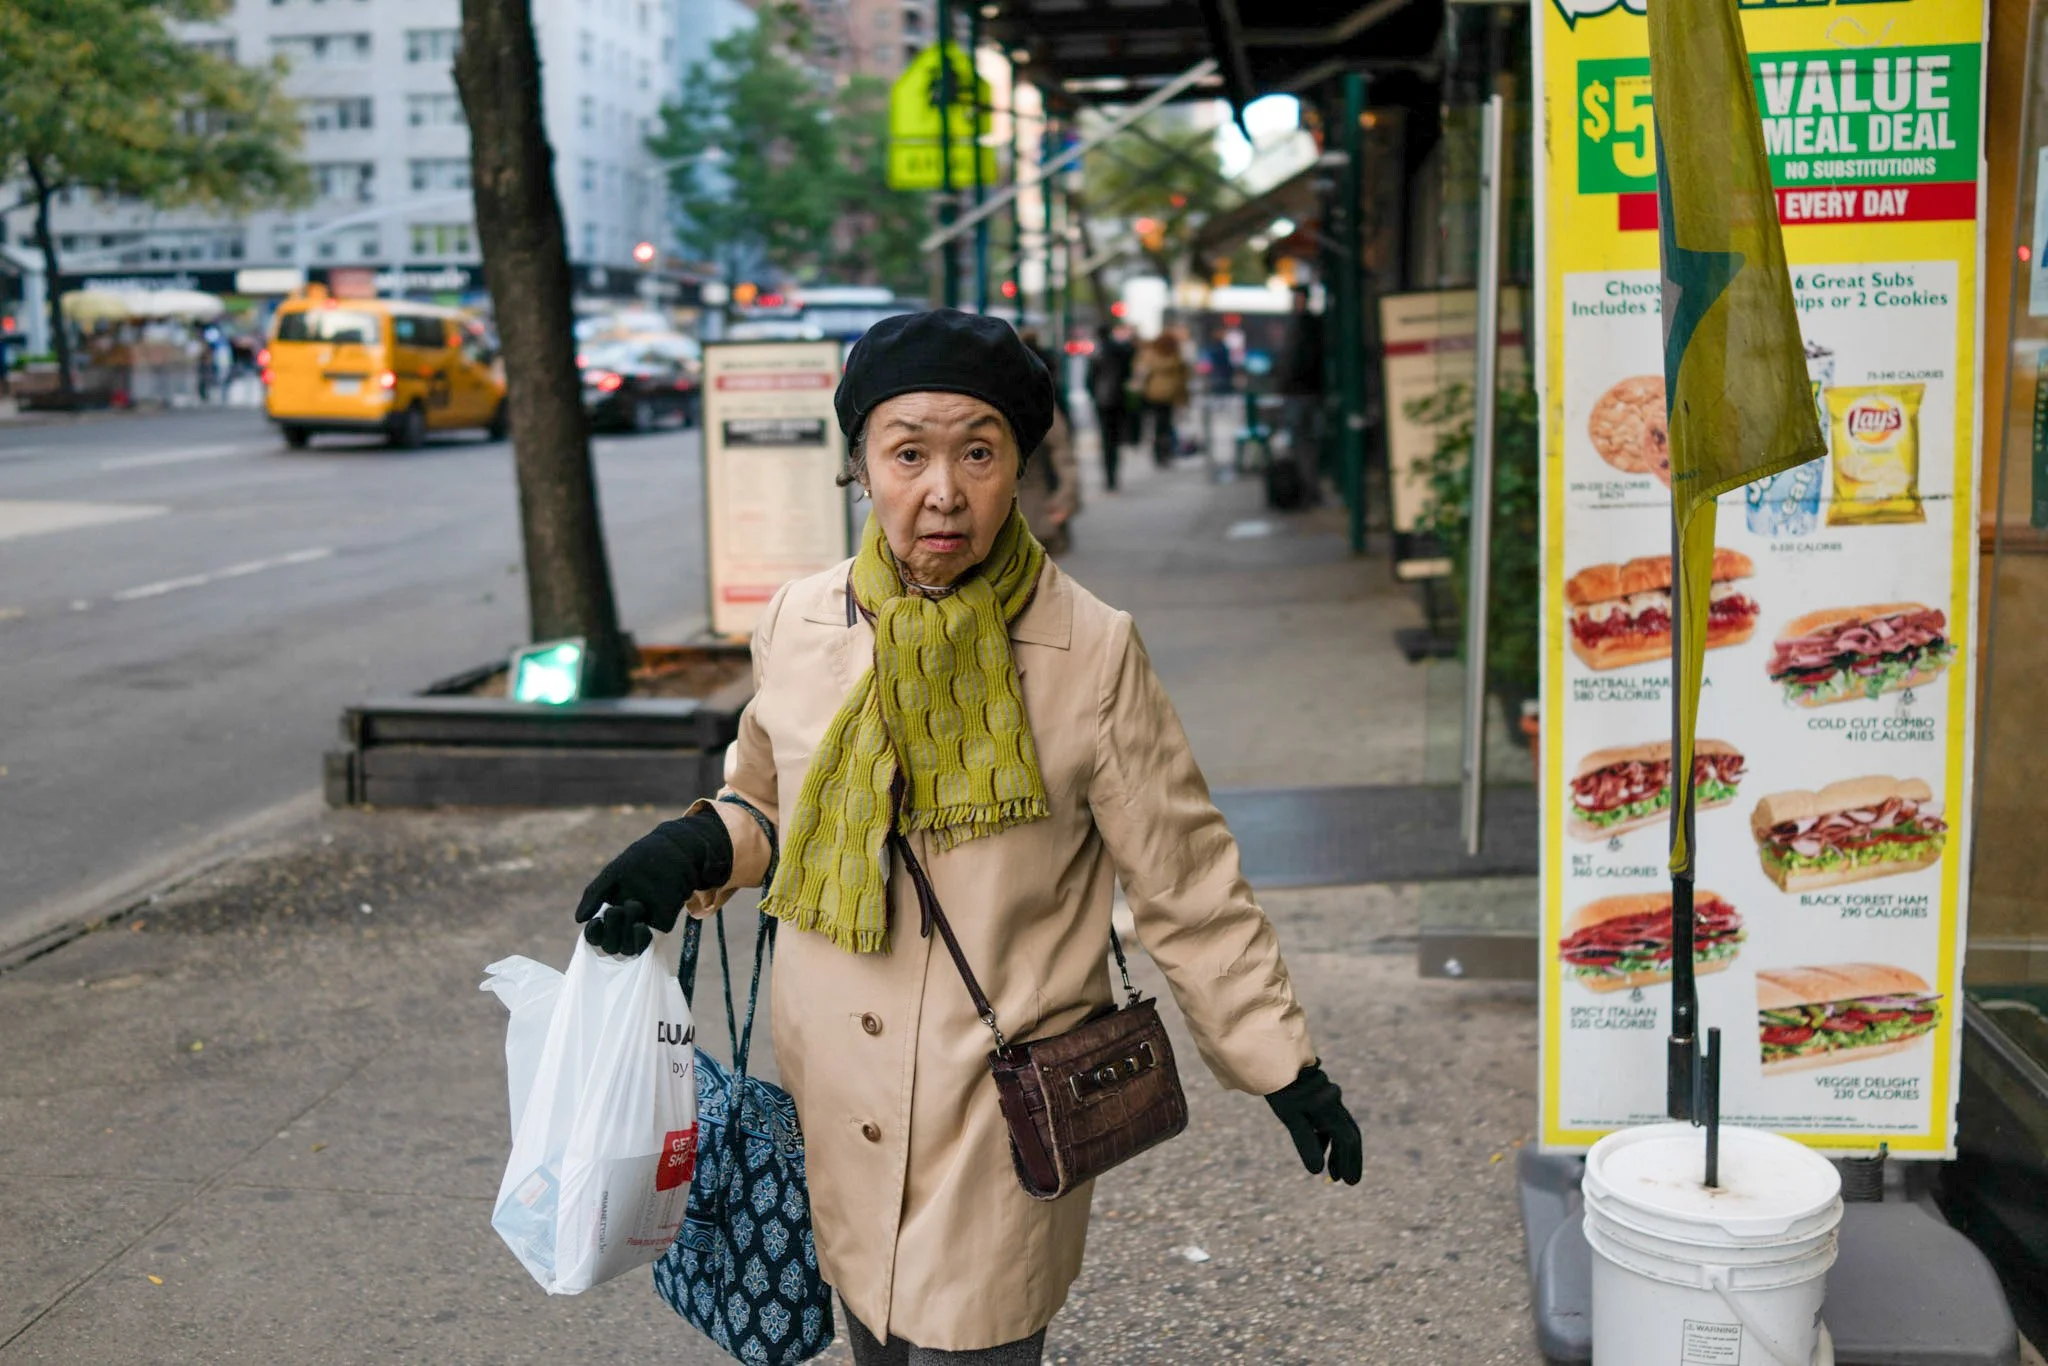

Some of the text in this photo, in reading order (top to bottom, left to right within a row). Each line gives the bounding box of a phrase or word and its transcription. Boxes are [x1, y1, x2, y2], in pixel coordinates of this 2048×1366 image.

[1760, 55, 1950, 115] VALUE
[1582, 75, 1657, 178] $5
[1762, 112, 1956, 155] MEAL DEAL
[1785, 157, 1936, 179] NO SUBSTITUTIONS
[1785, 189, 1857, 219] EVERY
[1863, 188, 1909, 216] DAY
[1605, 272, 1914, 296] Choos 6 Great Subs
[1572, 300, 1646, 316] Includes
[1794, 293, 1824, 312] ips
[1831, 296, 1851, 307] or
[1857, 291, 1867, 307] 2
[1874, 289, 1948, 306] Cookies
[1573, 677, 1712, 688] MEATBALL MARA
[1597, 690, 1661, 701] CALORIES
[1807, 717, 1935, 729] COLD CUT COMBO
[1845, 730, 1934, 741] 410 CALORIES
[1572, 854, 1593, 864] BLT
[1596, 866, 1658, 877] CALORIES
[1800, 894, 1928, 905] BLACK FOREST HAM
[1841, 907, 1928, 918] 290 CALORIES
[1570, 1006, 1657, 1017] SPICY ITALIAN
[1594, 1018, 1655, 1029] CALORIES
[672, 1059, 689, 1078] by
[1815, 1076, 1920, 1088] VEGGIE DELIGHT
[1833, 1088, 1919, 1100] 230 CALORIES
[1696, 1324, 1739, 1334] WARNING
